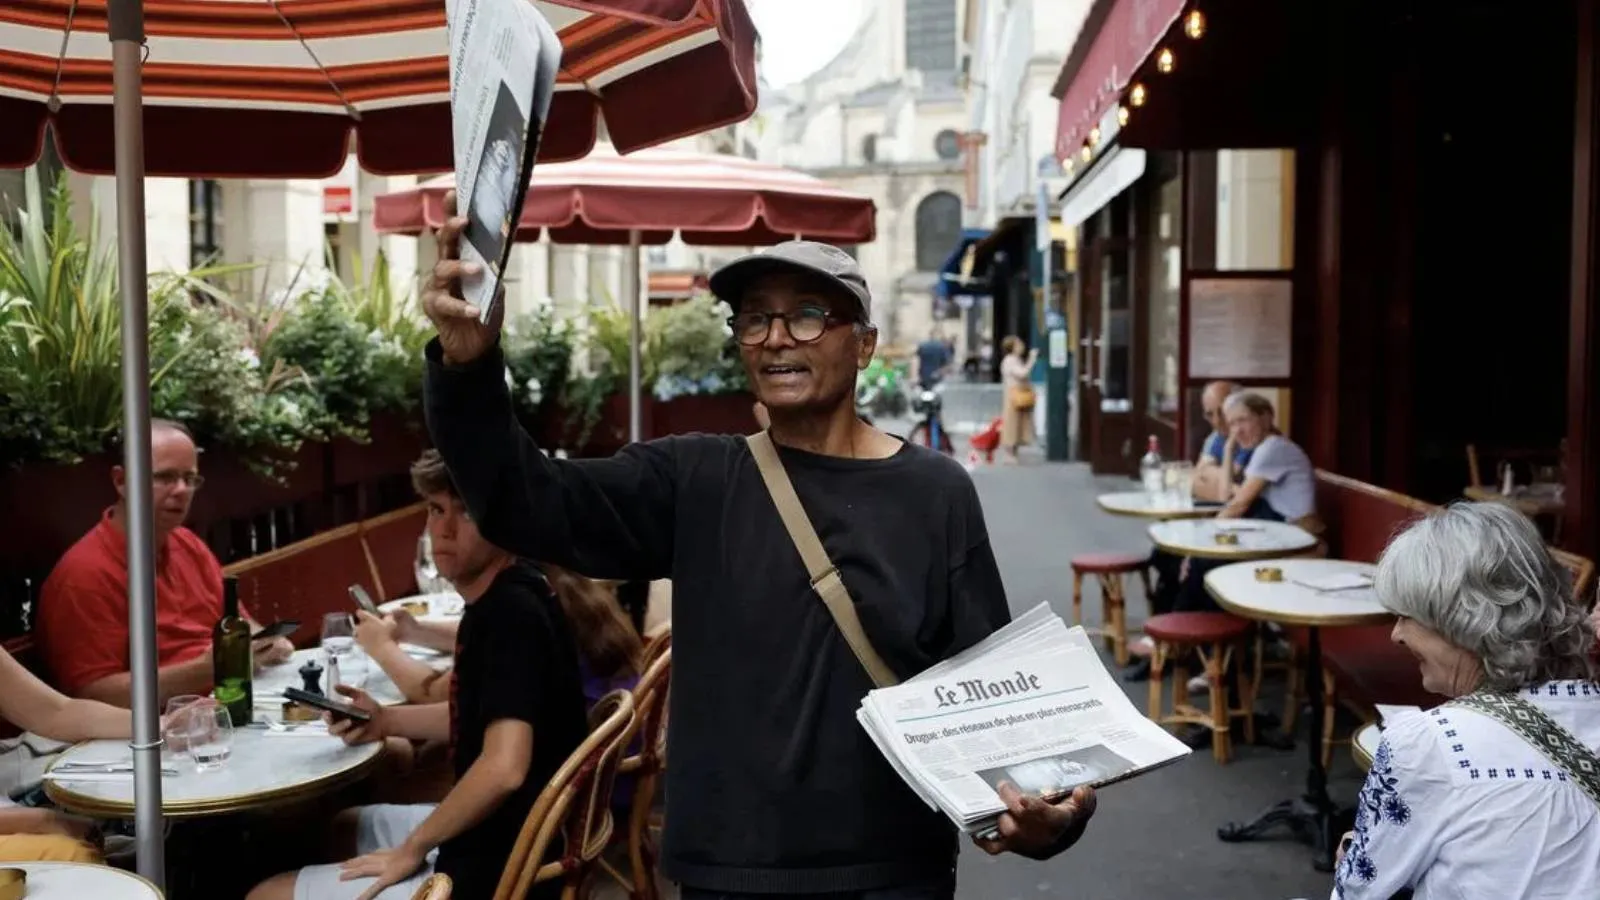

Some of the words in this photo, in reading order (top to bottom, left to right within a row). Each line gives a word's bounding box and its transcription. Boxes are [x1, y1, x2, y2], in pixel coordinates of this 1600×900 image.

[934, 685, 959, 708] Le
[956, 671, 1042, 702] Monde
[904, 730, 939, 745] Drogue
[942, 724, 959, 738] des
[960, 718, 994, 733] réseaux
[994, 715, 1006, 728] de
[1006, 712, 1024, 728] plus
[1025, 710, 1037, 721] en
[1037, 706, 1056, 722] plus
[1056, 698, 1103, 715] menaçants
